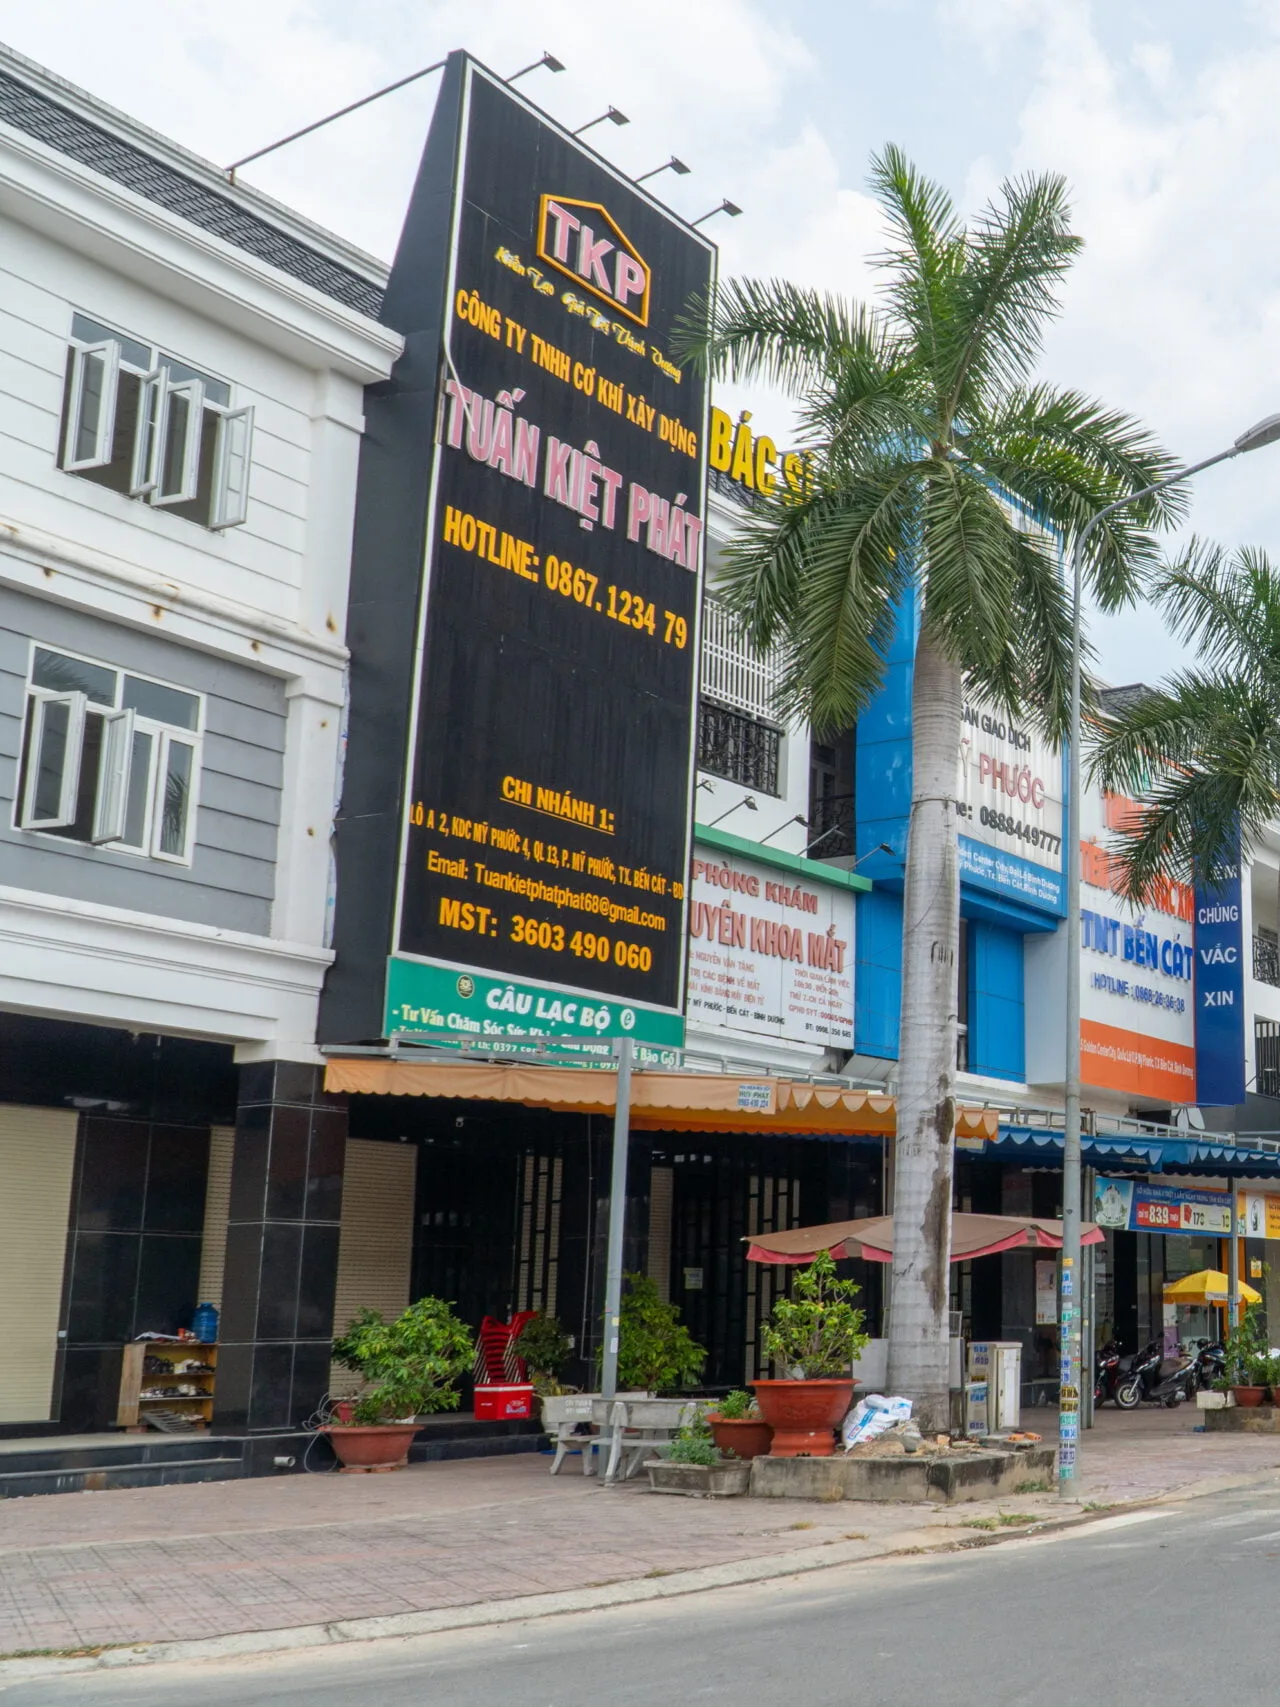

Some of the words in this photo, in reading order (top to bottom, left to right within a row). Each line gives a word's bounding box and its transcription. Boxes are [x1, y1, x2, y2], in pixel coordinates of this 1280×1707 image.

[547, 200, 646, 304] TKP
[456, 289, 501, 340] CÔNG
[505, 317, 527, 354] TY
[531, 334, 571, 383] TNHH
[573, 362, 596, 396] CƠ
[599, 376, 624, 415] KHÍ
[627, 394, 656, 432] XÂY
[659, 413, 697, 459] DỰNG
[446, 379, 540, 488] TUẤN
[544, 440, 622, 532] KIỆT
[627, 482, 702, 573] PHÁT
[709, 406, 776, 497] BÁC
[444, 505, 540, 583] HOTLINE:
[664, 610, 687, 649] 79
[981, 714, 1006, 741] GIAO
[1008, 725, 1031, 752] DỊCH
[502, 775, 533, 805] CHI
[537, 786, 596, 826] NHÁNH
[599, 808, 615, 832] 1:
[979, 752, 1045, 809] PHƯỚC
[410, 801, 424, 827] LÔ
[426, 809, 435, 829] A
[438, 813, 449, 837] 2,
[452, 816, 472, 840] KDC
[473, 821, 489, 845] MỸ
[491, 828, 521, 853] PHƯỚC
[522, 838, 530, 860] 4,
[534, 841, 544, 863] QL
[547, 845, 559, 868] 13,
[562, 849, 570, 868] P.
[572, 851, 586, 872] MỸ
[588, 856, 616, 885] PHƯỚC,
[619, 866, 632, 886] TX.
[634, 867, 650, 891] BẾN
[651, 873, 667, 895] CÁT
[980, 805, 1062, 855] 0888449777
[428, 850, 469, 879] Email:
[474, 862, 666, 931] Tuankietphatphat68@gmail.com
[692, 859, 760, 897] PHÒNG
[765, 881, 818, 914] KHÁM
[1199, 902, 1239, 925] CHỦNG
[439, 897, 498, 937] MST:
[511, 915, 565, 952] 3603
[570, 930, 609, 962] 490
[615, 940, 652, 971] 060
[690, 899, 746, 949] UYÊN
[751, 916, 803, 963] KHOA
[808, 923, 848, 974] MẮT
[1080, 907, 1120, 957] TNT
[1123, 914, 1158, 971] BẾN
[1162, 933, 1194, 982] CÁT
[1201, 943, 1237, 965] VẮC
[486, 985, 533, 1015] CÂU
[535, 997, 578, 1027] LẠC
[580, 1005, 611, 1035] BỘ
[1094, 975, 1129, 998] HOTLINE
[1204, 989, 1234, 1007] XIN
[447, 1012, 480, 1033] Chăm
[1148, 1205, 1169, 1224] 839
